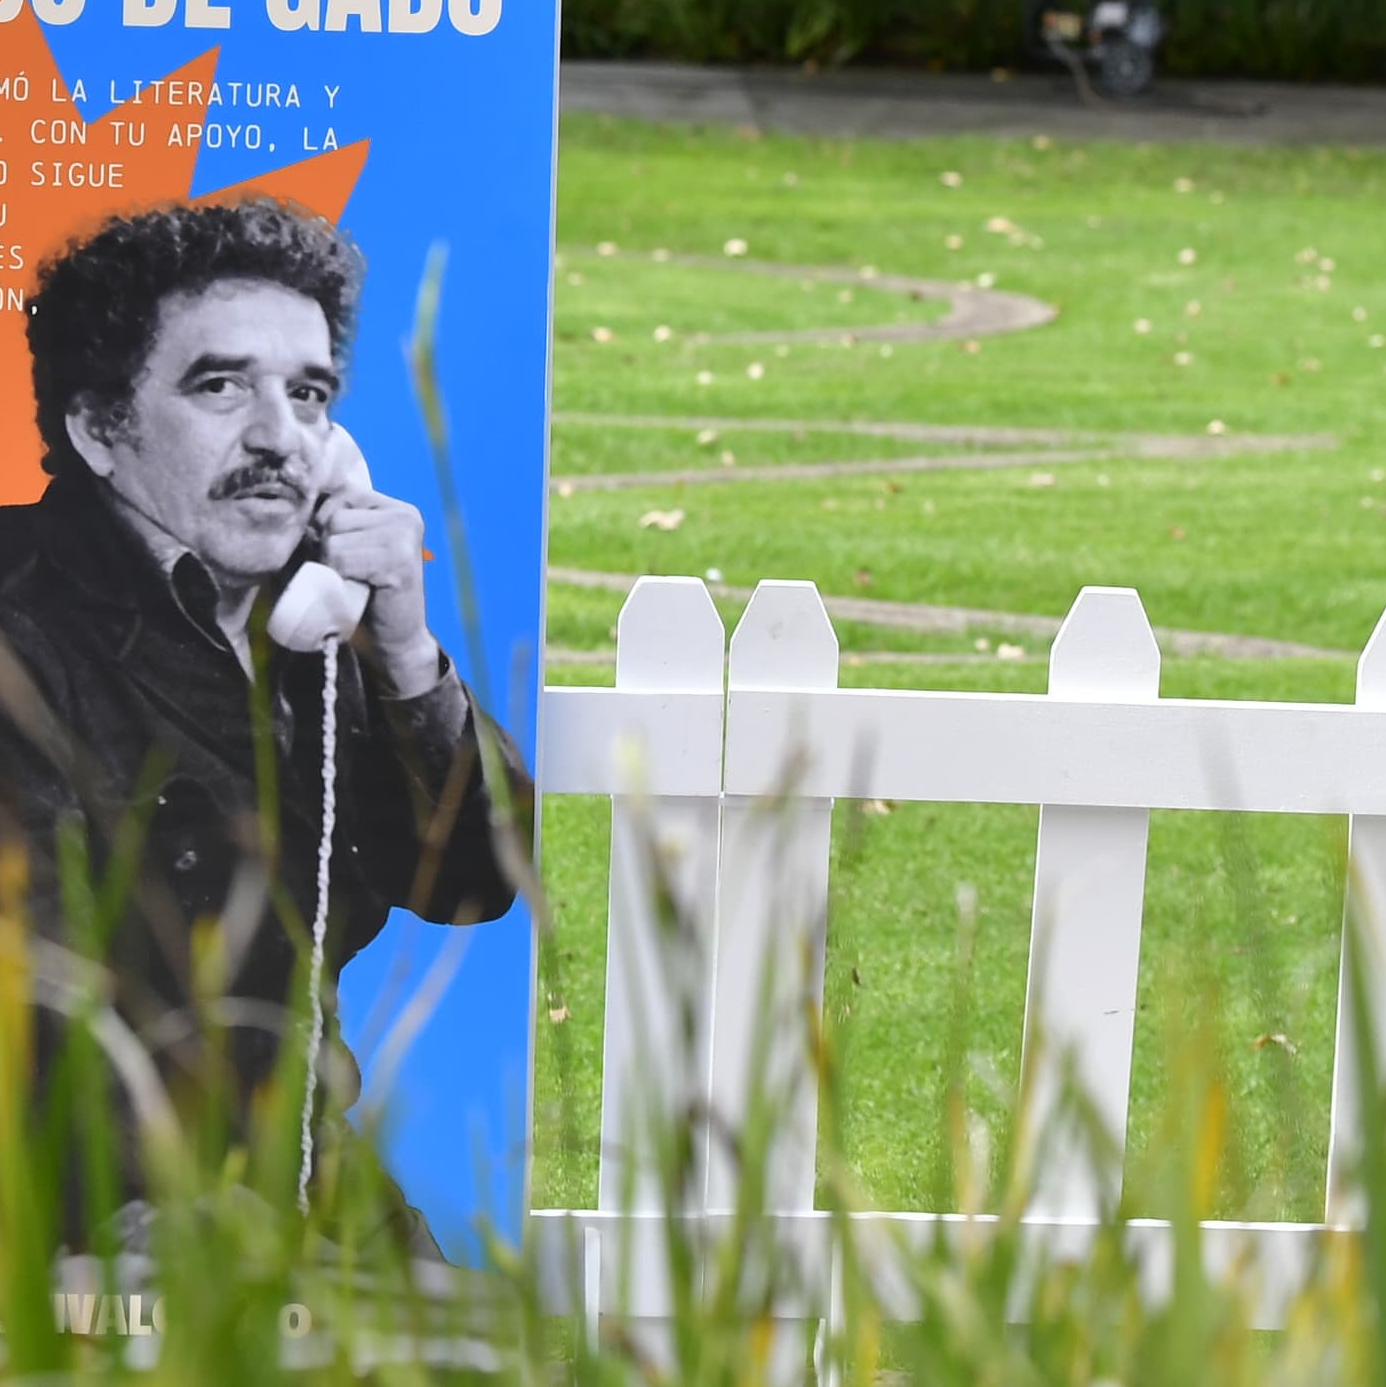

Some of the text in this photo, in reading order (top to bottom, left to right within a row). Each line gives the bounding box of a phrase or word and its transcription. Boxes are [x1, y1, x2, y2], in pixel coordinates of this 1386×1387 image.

[52, 78, 87, 103] LA
[110, 80, 300, 108] LITERATURA
[324, 85, 339, 108] Y
[30, 119, 87, 145] CON
[110, 121, 145, 146] TU
[167, 123, 275, 152] APOYO,
[303, 127, 339, 151] LA
[31, 161, 123, 188] SIGUE
